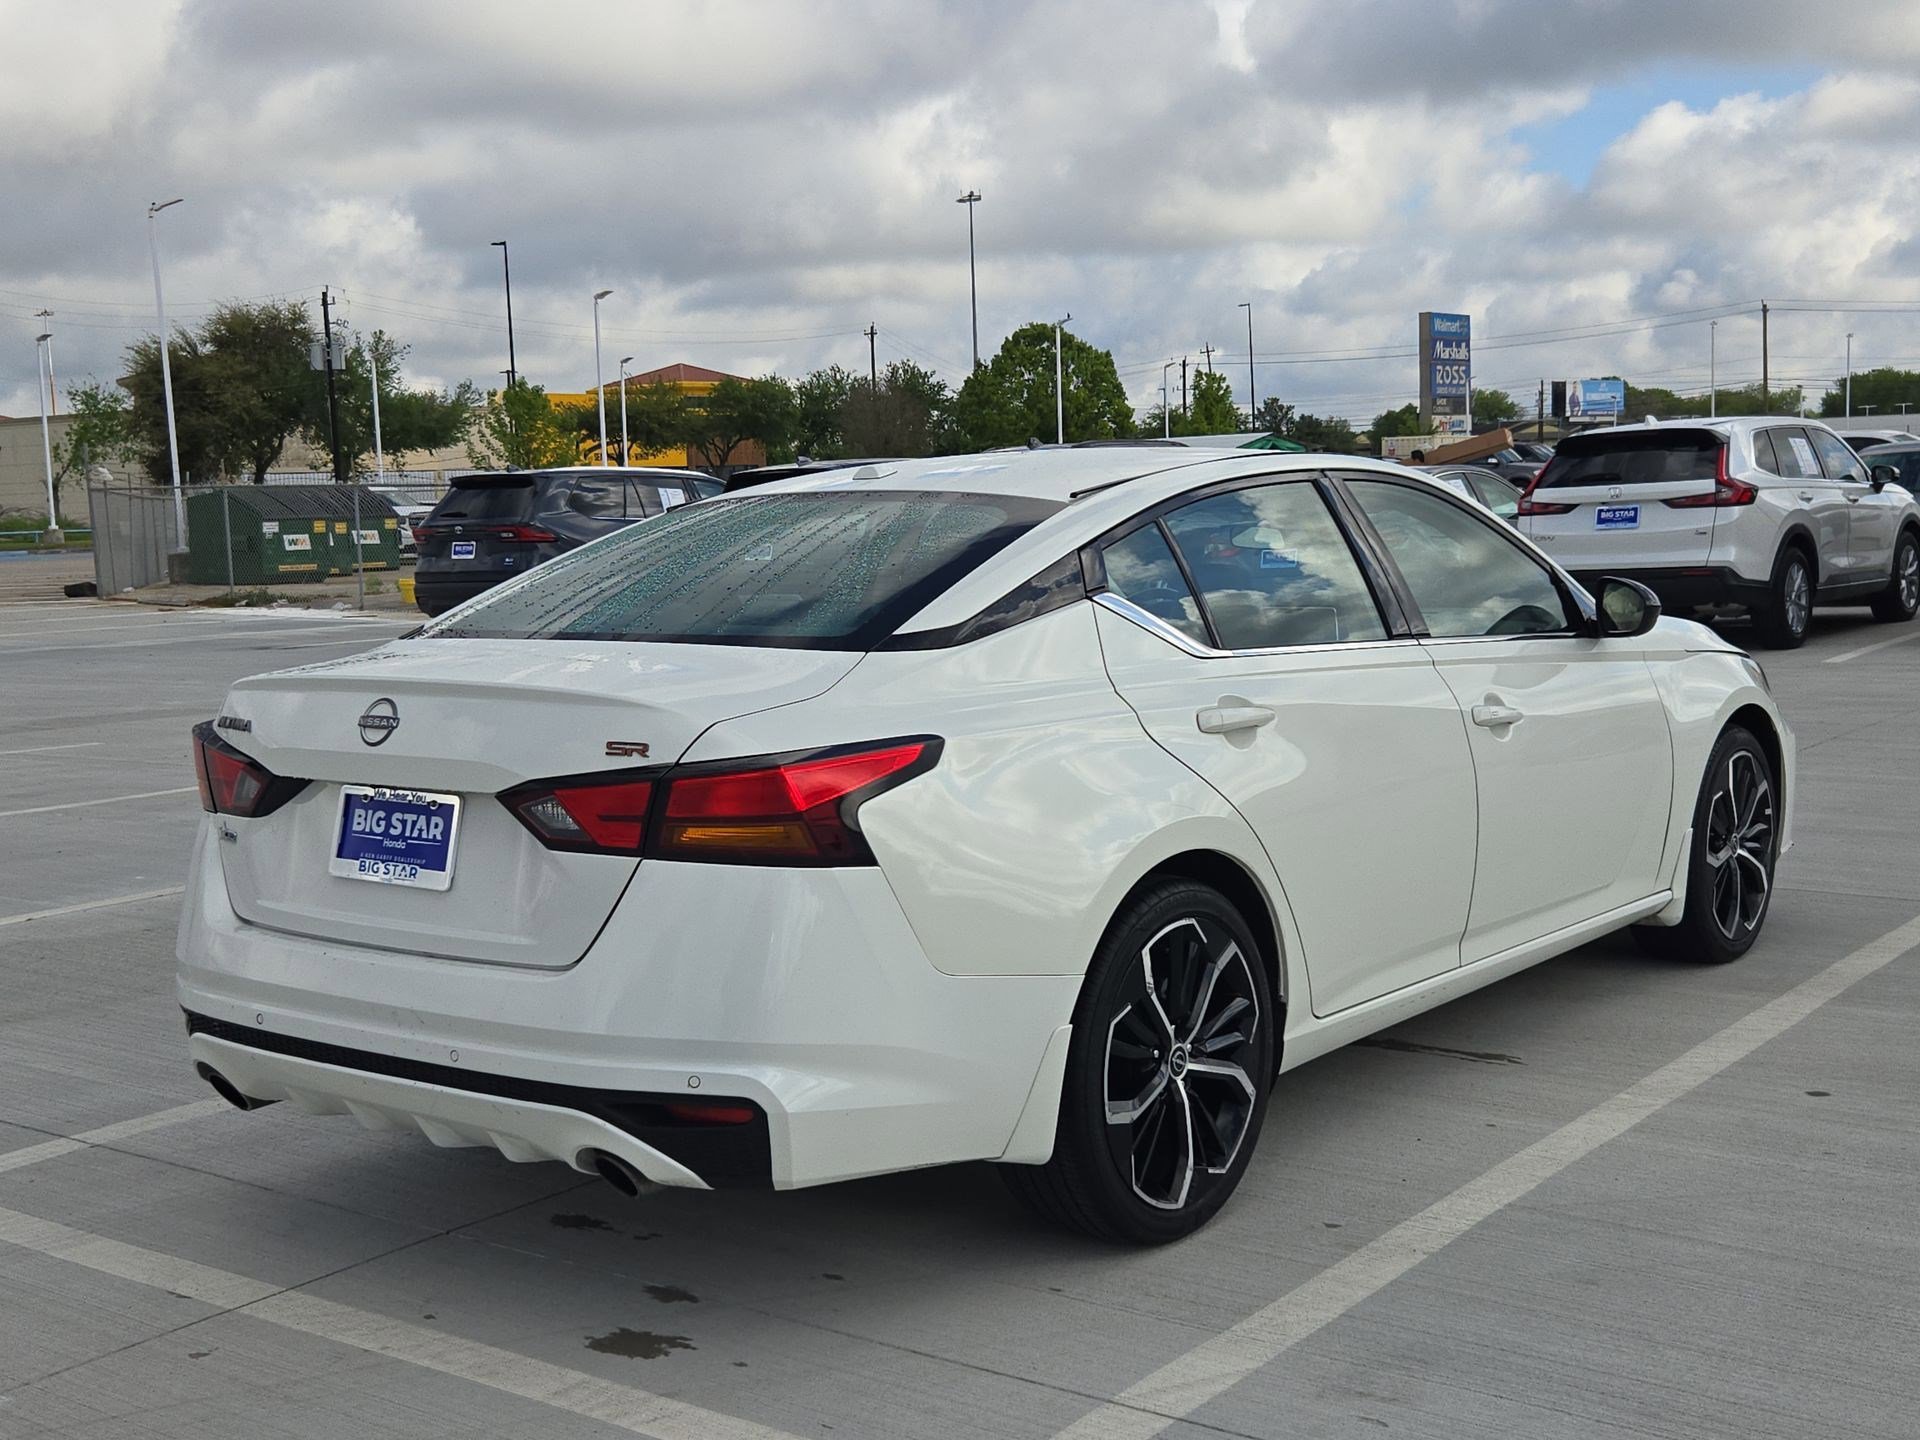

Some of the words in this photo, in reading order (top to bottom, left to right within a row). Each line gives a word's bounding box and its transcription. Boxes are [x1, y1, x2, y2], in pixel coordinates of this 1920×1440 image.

[1433, 317, 1460, 333] Walmart
[1433, 340, 1469, 361] Marshalls
[1436, 365, 1466, 385] ROSS
[1600, 511, 1614, 519] BIG
[1615, 509, 1635, 518] STAR
[605, 740, 650, 758] SR
[374, 788, 387, 800] We
[410, 791, 427, 804] You
[352, 808, 386, 834] BIG
[389, 812, 444, 840] STAR
[382, 837, 407, 849] Honda
[358, 860, 380, 874] BIG
[382, 863, 418, 879] STAR
